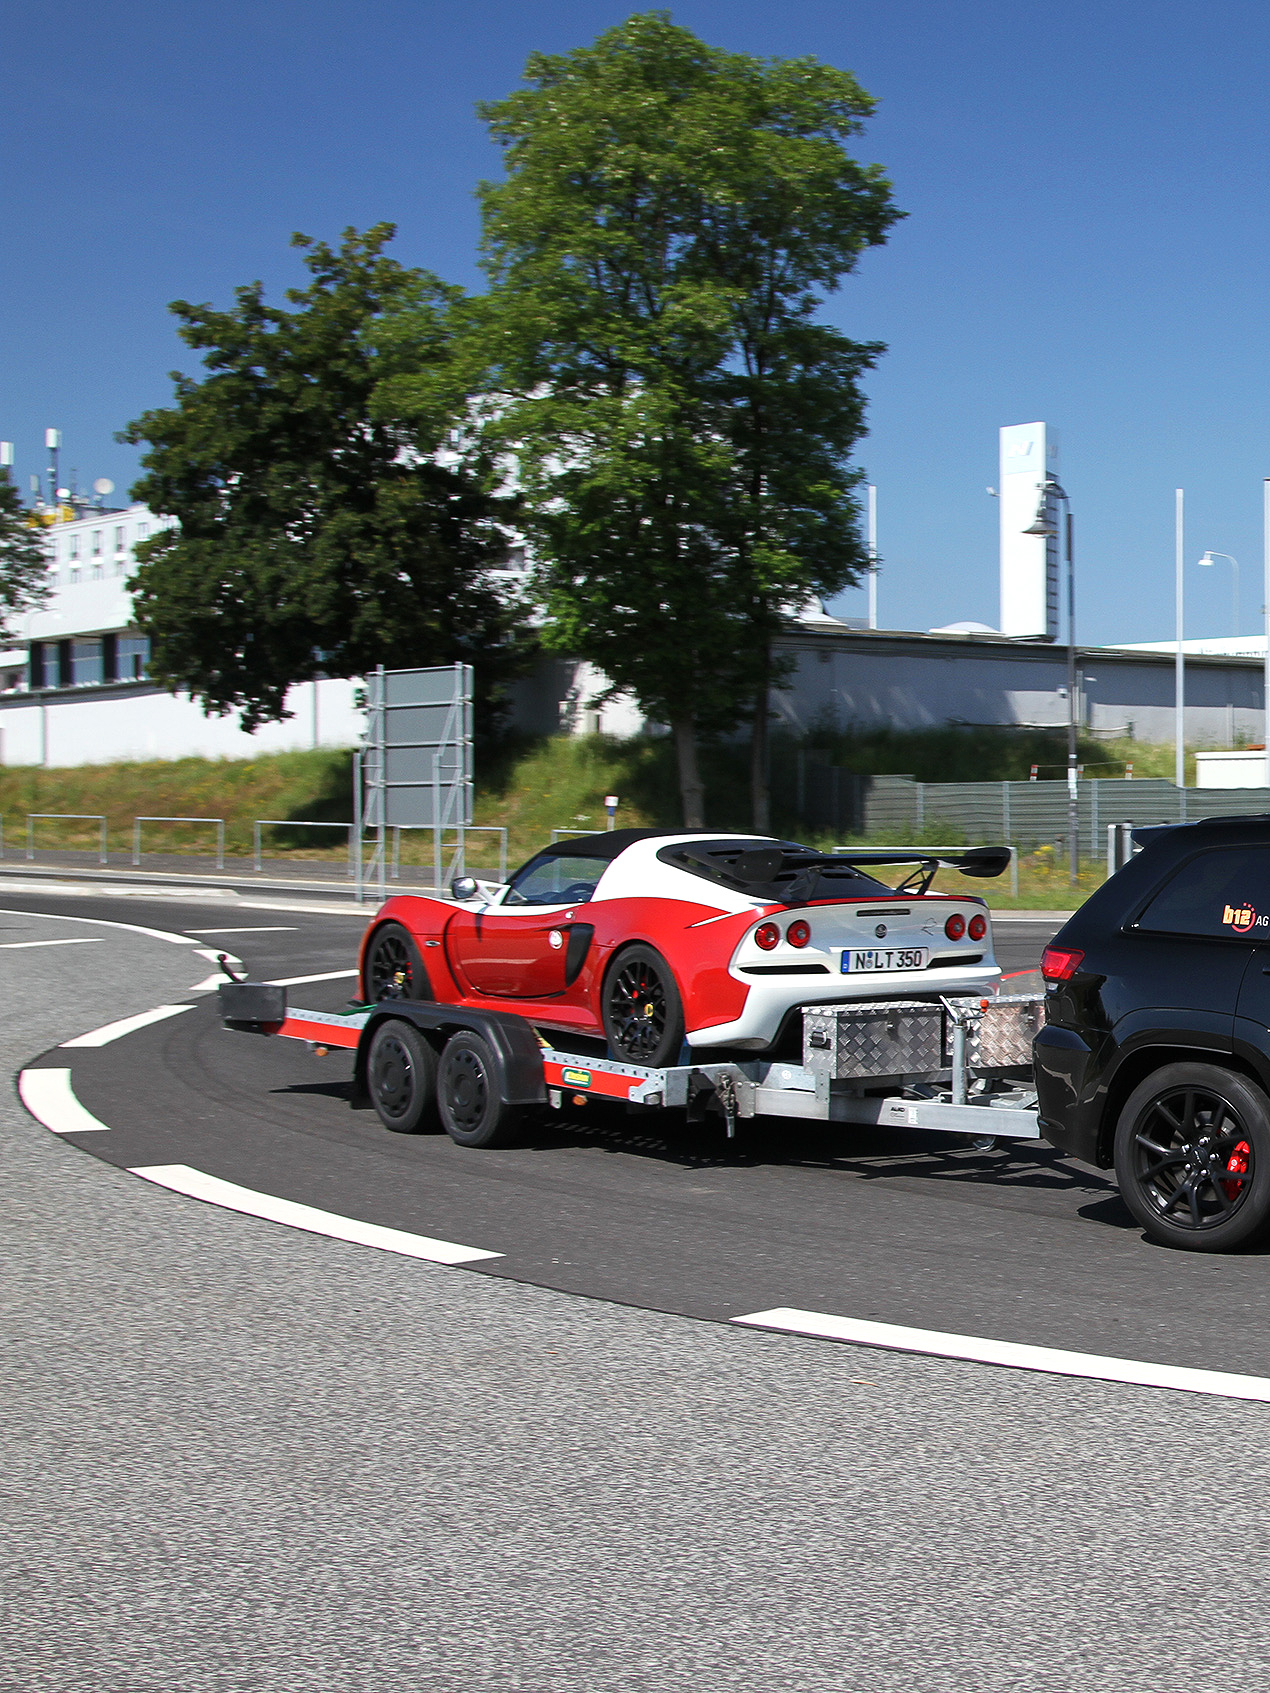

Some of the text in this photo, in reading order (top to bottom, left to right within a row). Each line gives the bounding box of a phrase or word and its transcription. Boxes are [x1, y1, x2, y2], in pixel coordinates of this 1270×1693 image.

[1222, 904, 1269, 926] b12 AG
[855, 950, 922, 969] N LT 350
